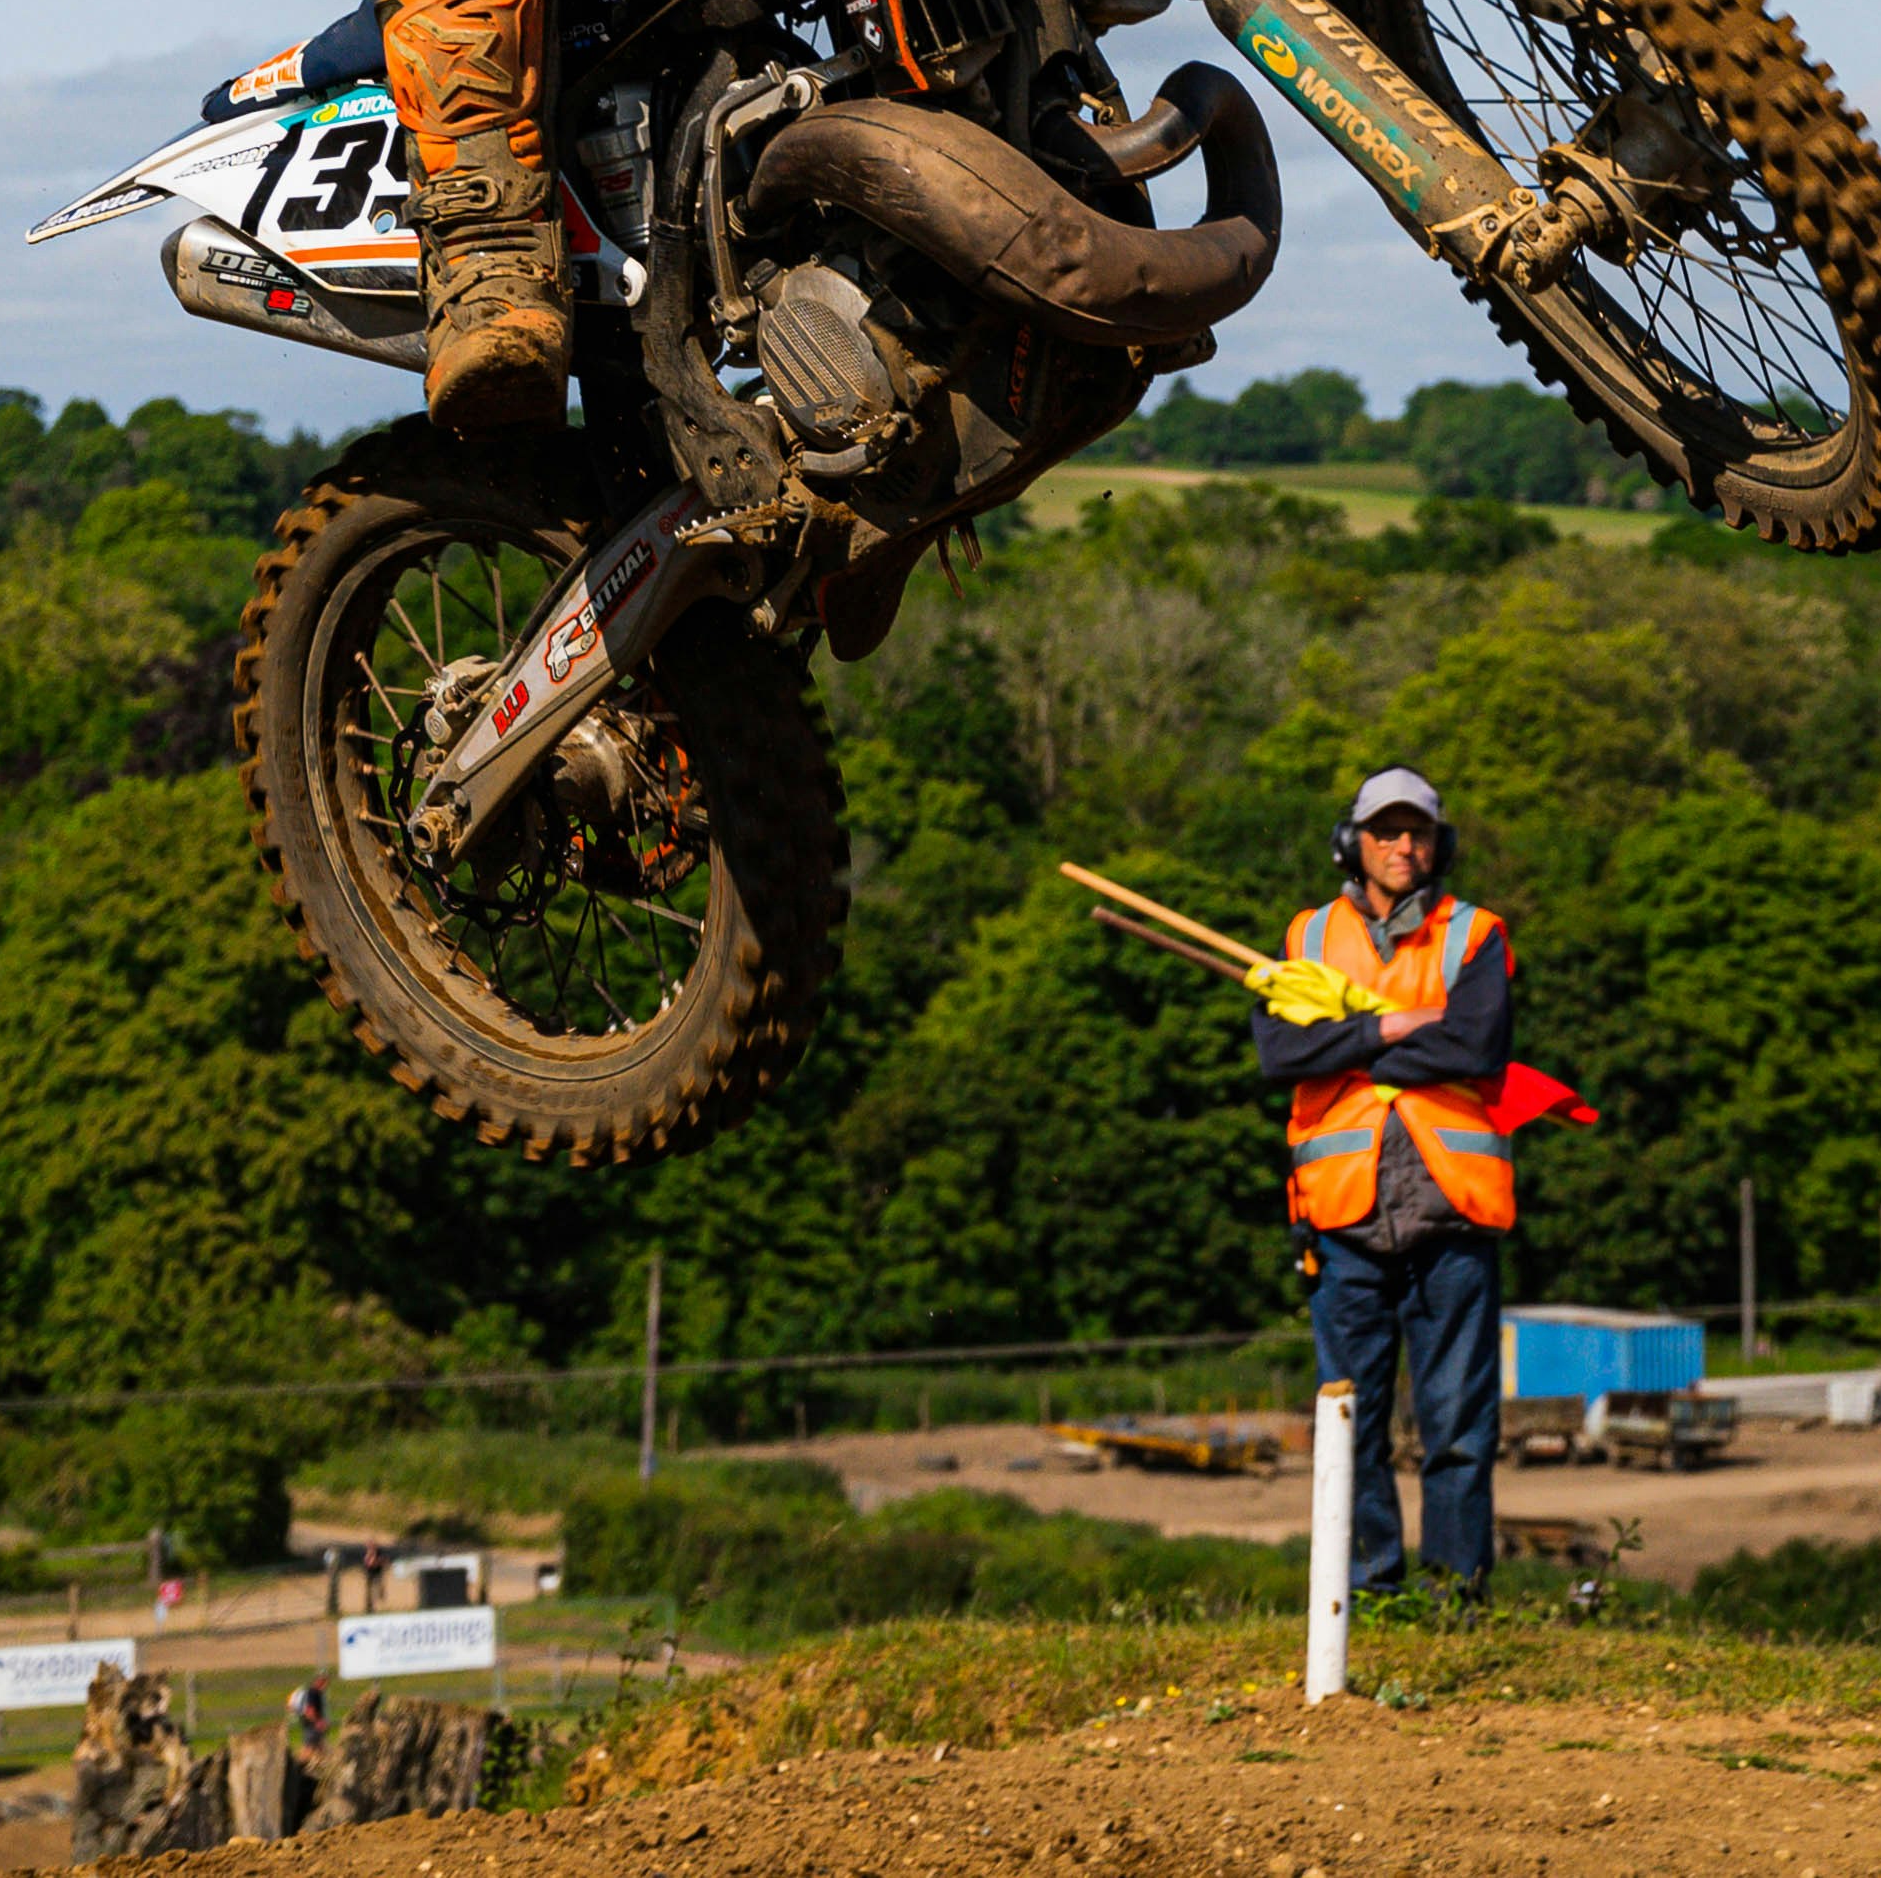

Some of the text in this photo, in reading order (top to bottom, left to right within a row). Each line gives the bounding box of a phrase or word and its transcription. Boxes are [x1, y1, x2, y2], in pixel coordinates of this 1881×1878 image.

[1295, 66, 1426, 192] MOTOREX
[267, 289, 312, 314] S2
[547, 543, 652, 682] RENTHAL
